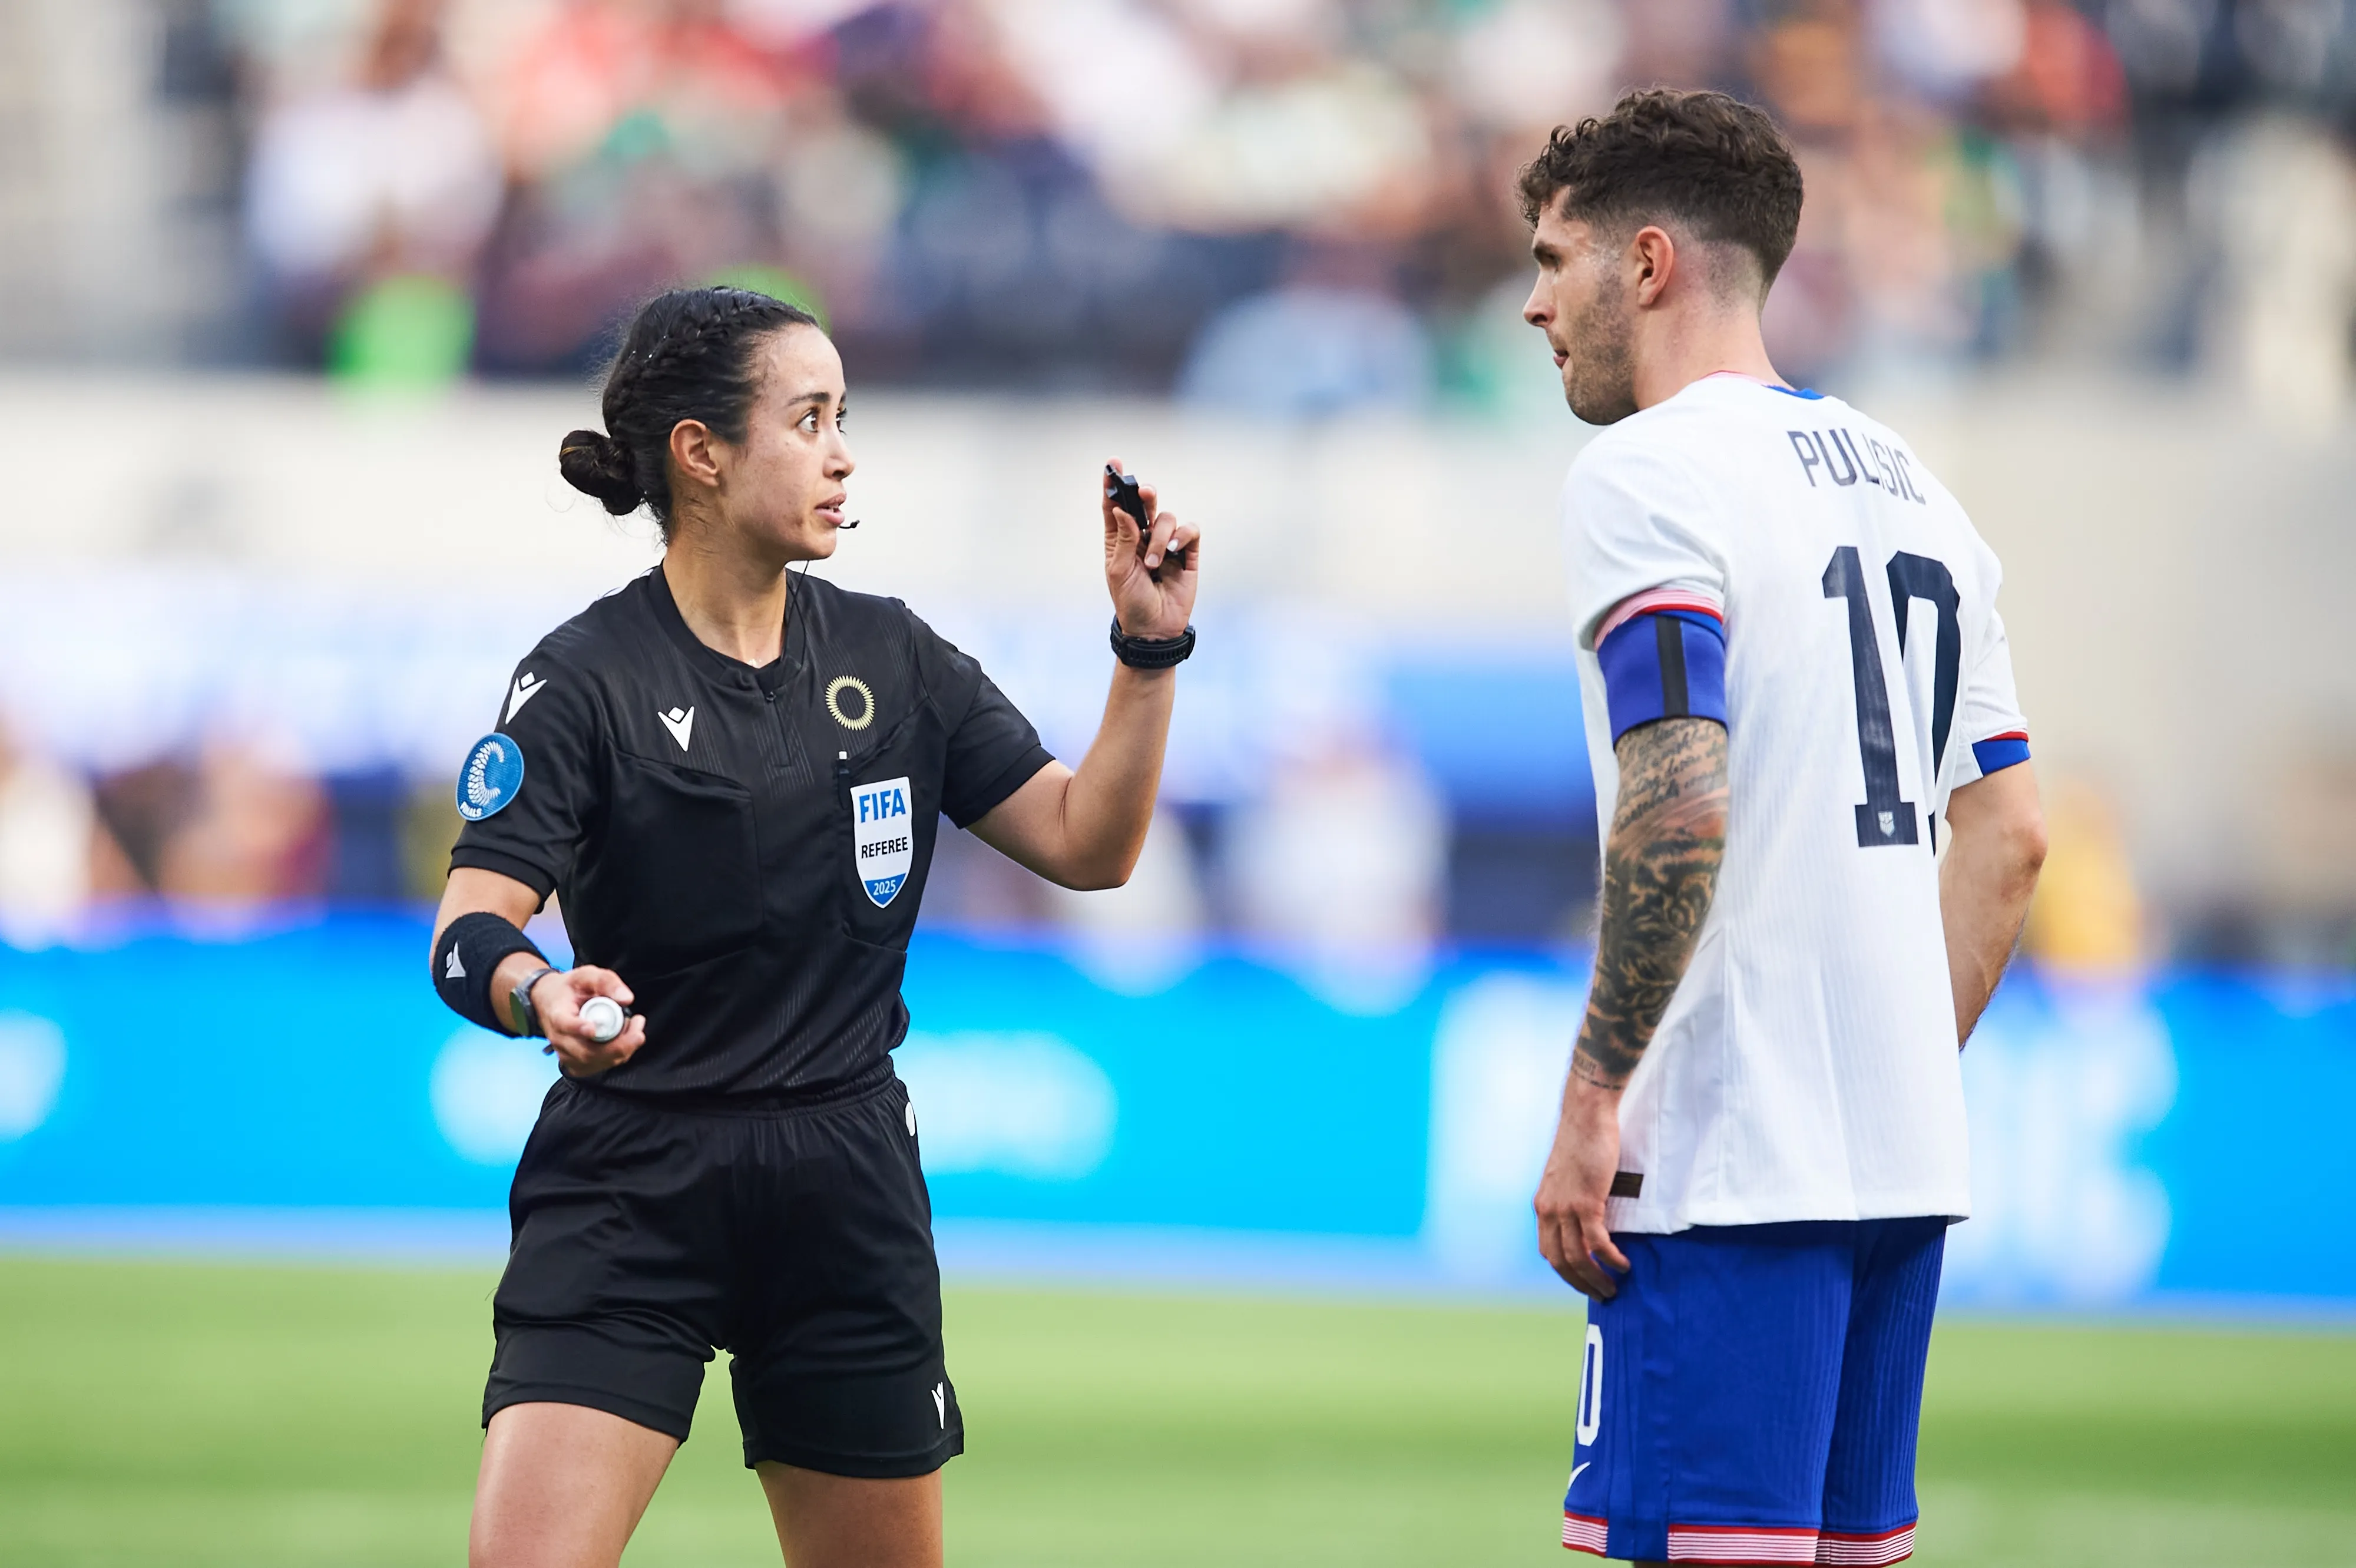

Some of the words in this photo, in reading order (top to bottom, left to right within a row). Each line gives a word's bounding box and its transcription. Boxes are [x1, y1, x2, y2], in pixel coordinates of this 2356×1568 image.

[1786, 428, 1926, 505] PULISIC
[1822, 545, 1961, 858] 10
[859, 788, 906, 823] FIFA
[861, 836, 908, 859] REFEREE
[873, 879, 896, 896] 2025
